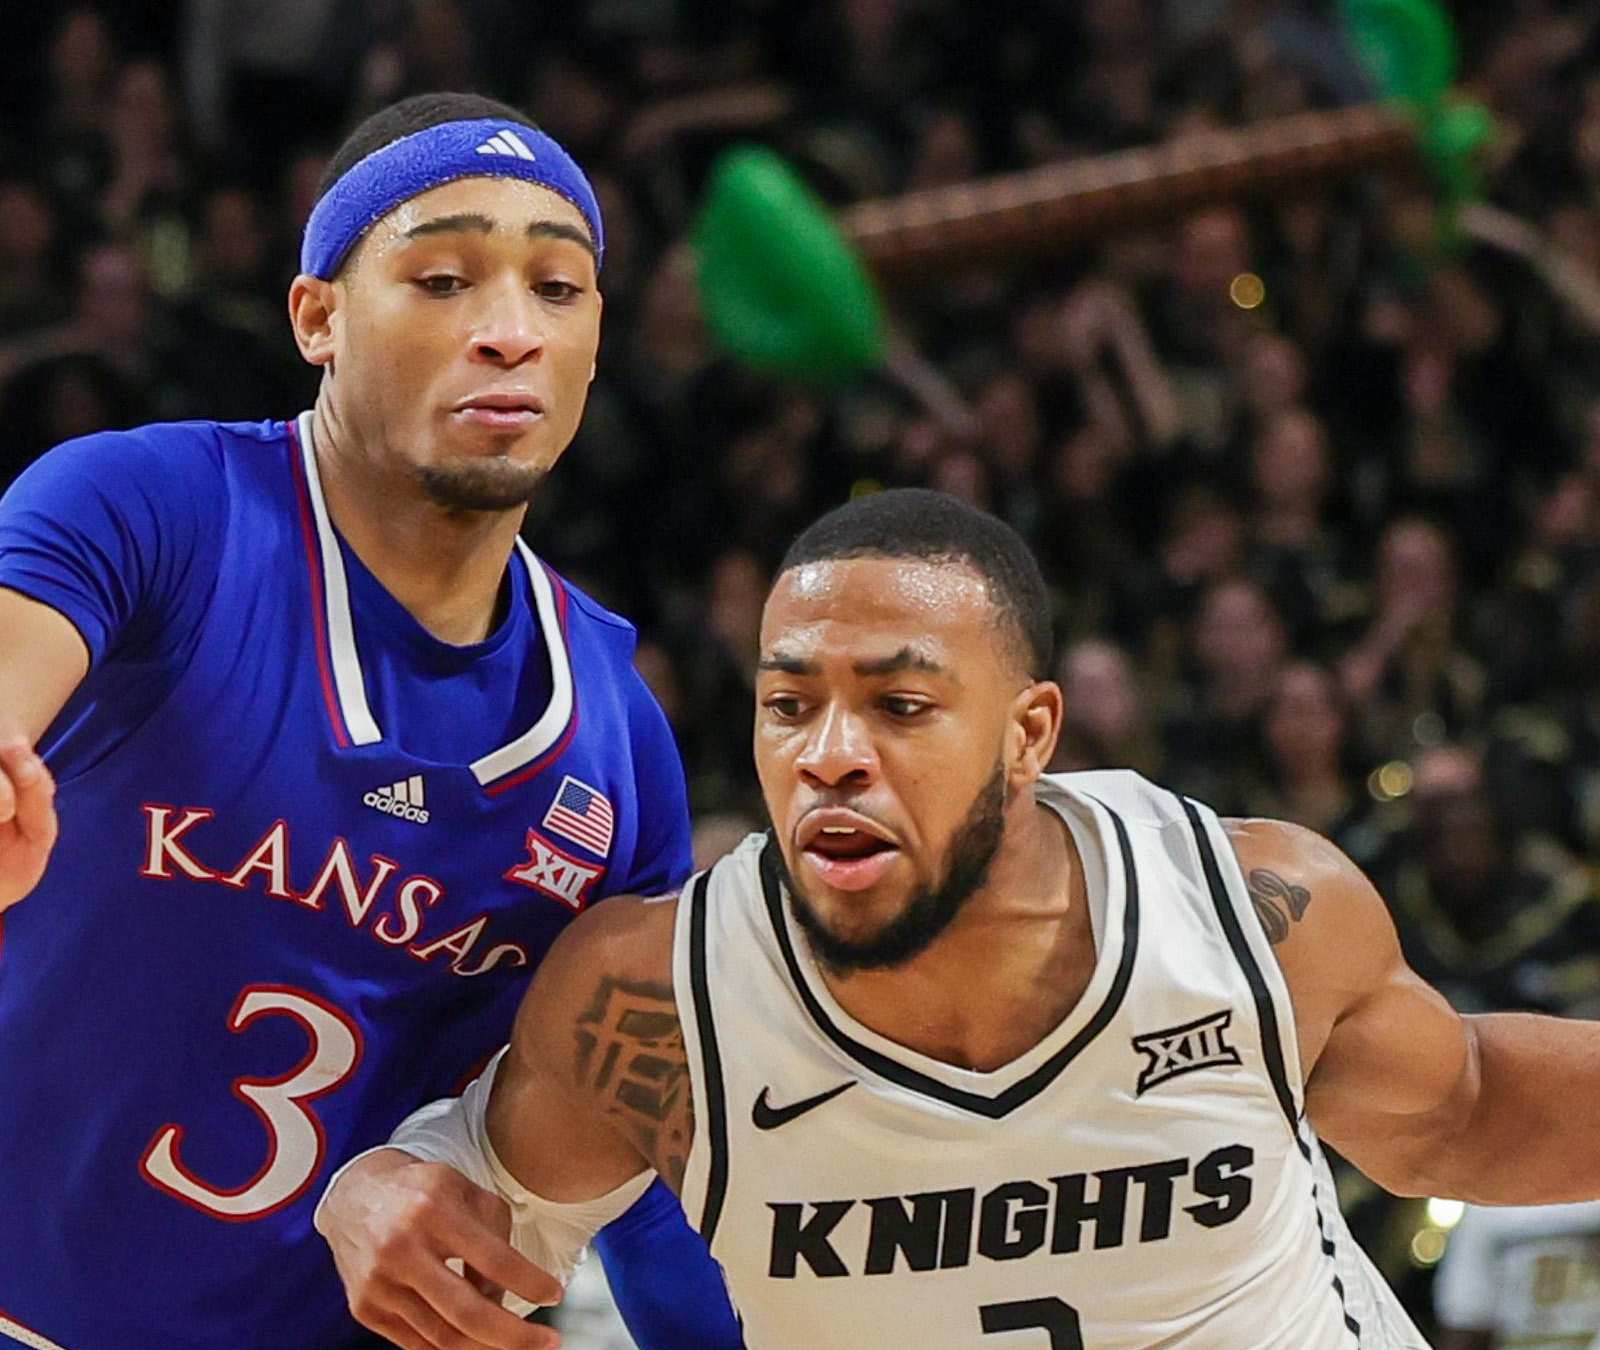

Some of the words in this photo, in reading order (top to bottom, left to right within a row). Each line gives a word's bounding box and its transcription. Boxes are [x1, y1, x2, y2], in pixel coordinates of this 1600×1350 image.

[363, 792, 430, 824] adidas
[142, 803, 527, 977] KANSAS
[508, 832, 604, 911] XII
[138, 984, 363, 1223] 3
[1133, 1011, 1241, 1096] XII
[766, 1144, 1254, 1279] KNIGHTS
